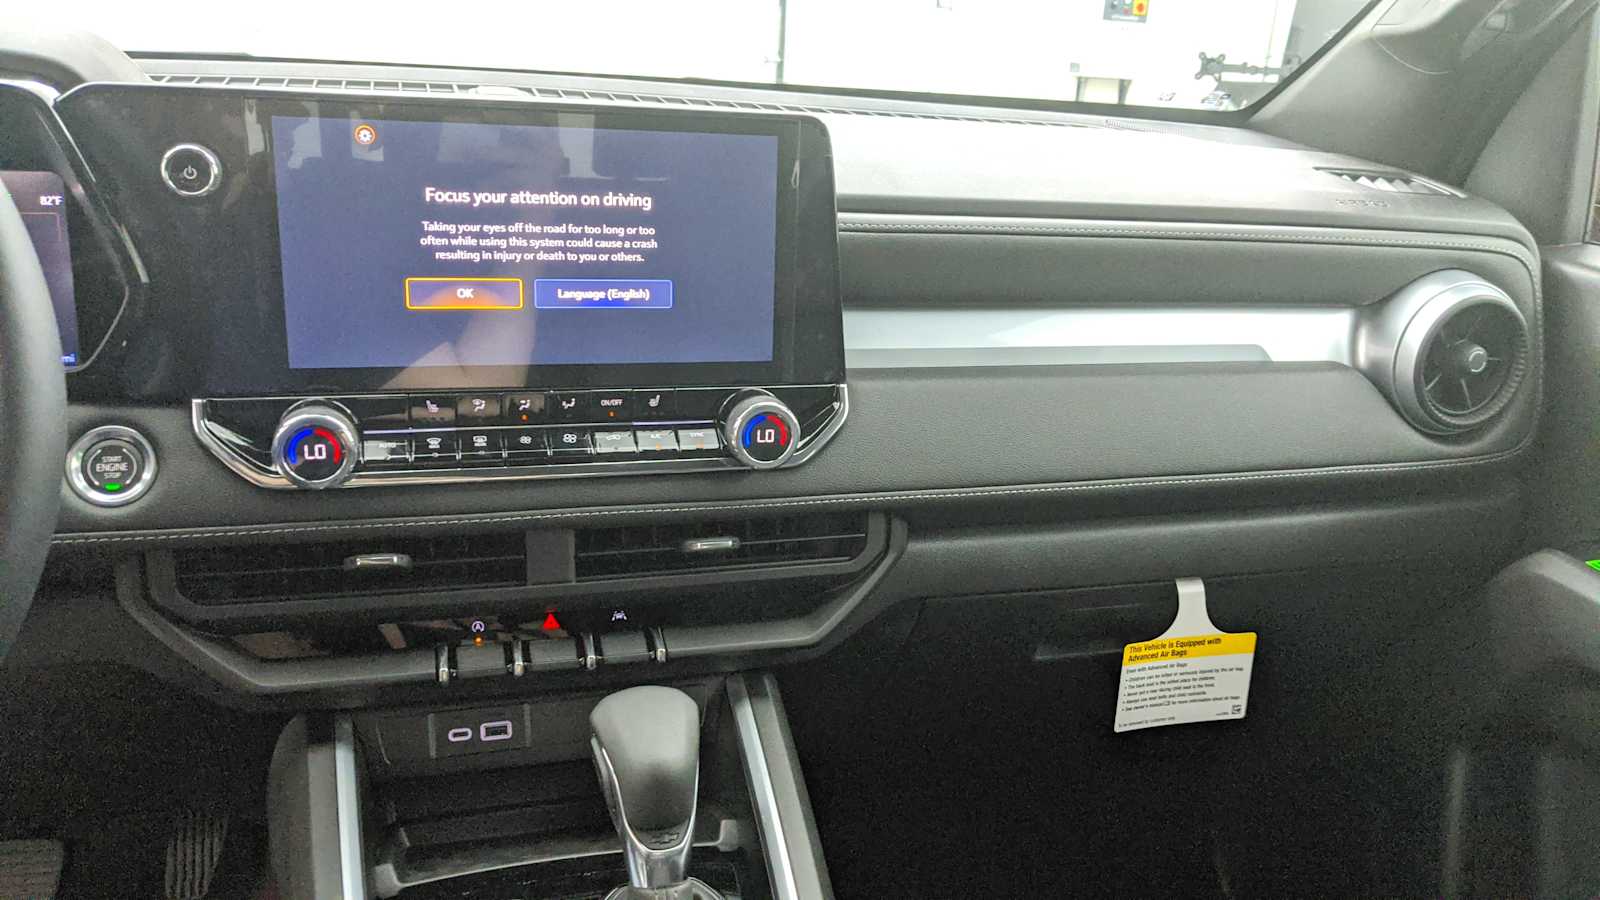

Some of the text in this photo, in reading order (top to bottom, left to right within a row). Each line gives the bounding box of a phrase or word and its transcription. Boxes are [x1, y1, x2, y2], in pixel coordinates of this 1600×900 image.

[425, 187, 652, 211] Focus your attention on driving
[421, 221, 656, 236] Taking your eyes off the road for too long or too
[420, 235, 658, 249] often while using this system could cause a crash
[435, 249, 645, 263] resulting in injury or death to you or others.
[456, 288, 474, 299] OK
[557, 288, 650, 301] Language (English)
[600, 398, 623, 407] ON/OFF
[757, 429, 775, 443] LO
[304, 443, 327, 460] LO
[96, 463, 128, 472] ENGINE
[1129, 645, 1142, 653] This
[1144, 642, 1167, 651] Vehicle
[1175, 639, 1206, 648] Equipped
[1128, 649, 1187, 662] Advanced Air Bags
